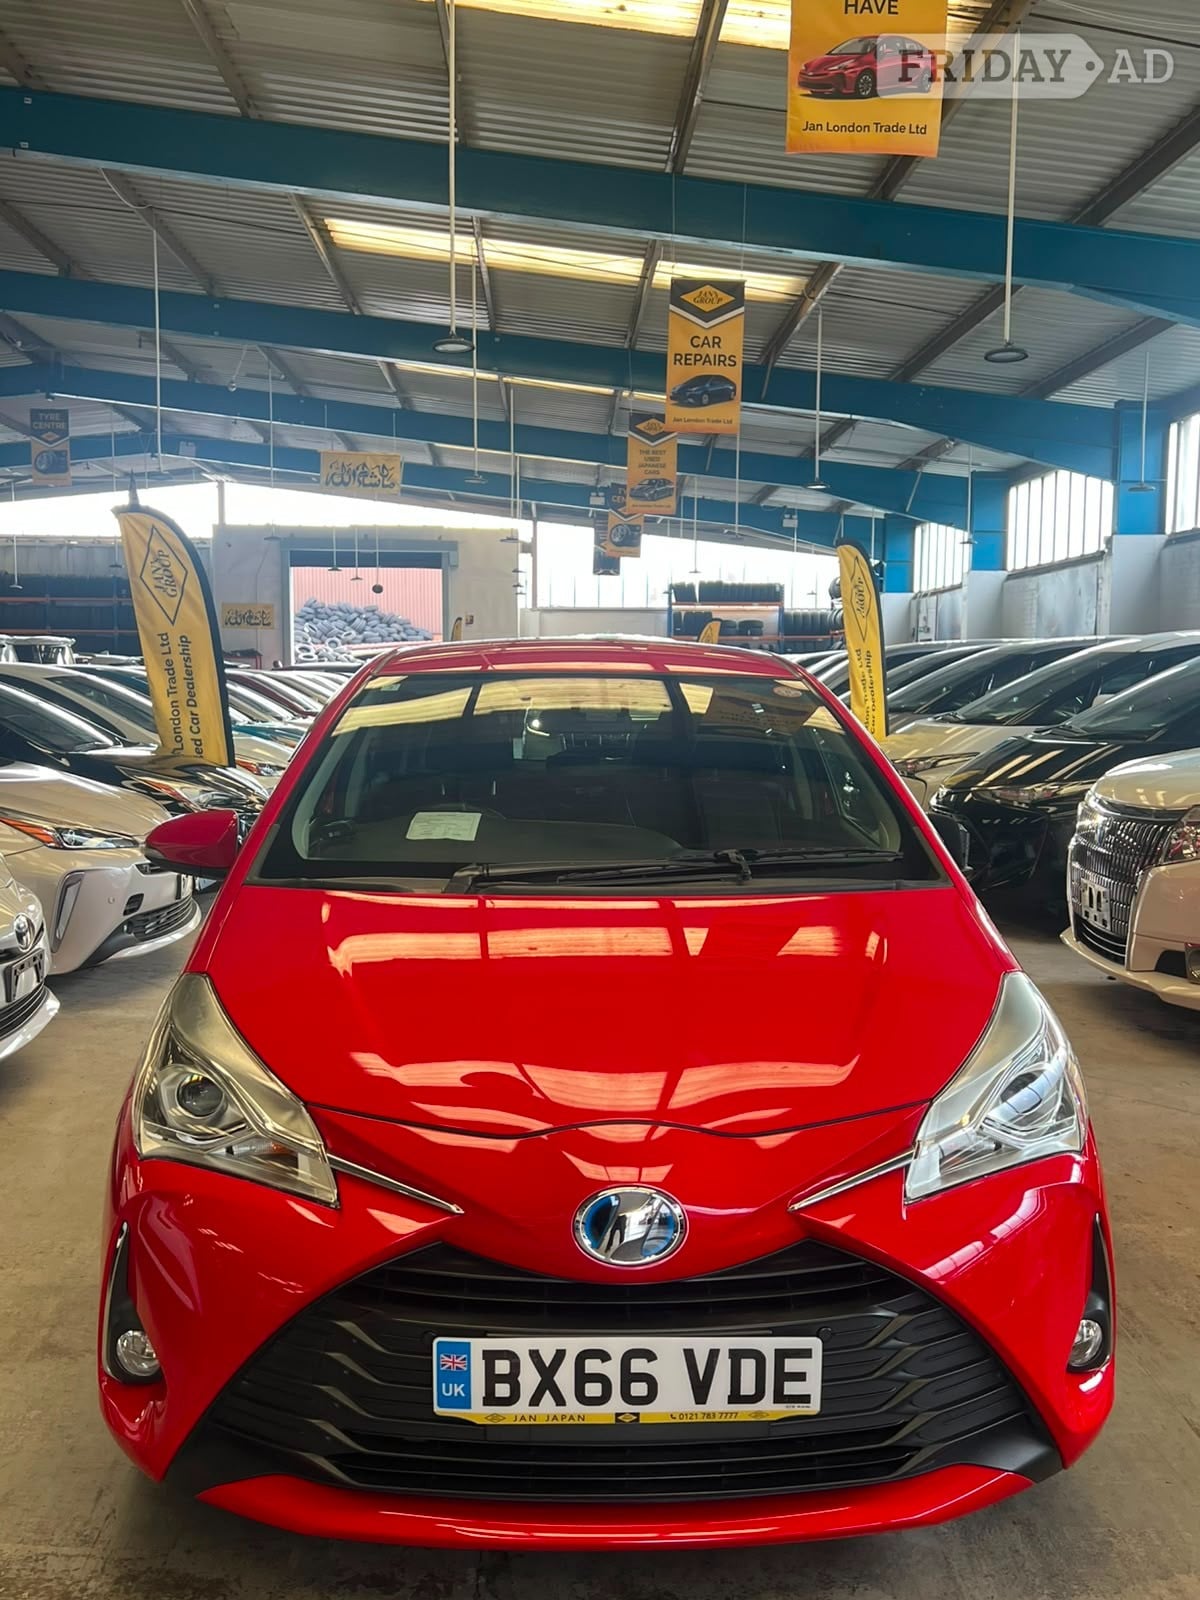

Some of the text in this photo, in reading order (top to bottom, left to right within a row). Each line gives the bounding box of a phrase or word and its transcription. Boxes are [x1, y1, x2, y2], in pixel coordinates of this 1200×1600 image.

[844, 0, 899, 15] HAVE
[802, 121, 927, 135] Jan London Trade Ltd
[690, 335, 722, 349] CAR
[673, 353, 737, 367] REPAIRS
[32, 421, 66, 430] CENTRE
[157, 550, 178, 597] GROUP
[156, 632, 171, 656] Ltd
[164, 659, 178, 698] Trade
[178, 635, 204, 758] ed Car Dealership
[169, 700, 184, 751] London
[482, 1347, 813, 1408] BX66 VDE
[442, 1384, 465, 1397] UK
[513, 1414, 586, 1422] JAN JAPAN
[678, 1412, 699, 1420] 0121
[719, 1411, 739, 1419] 7777
